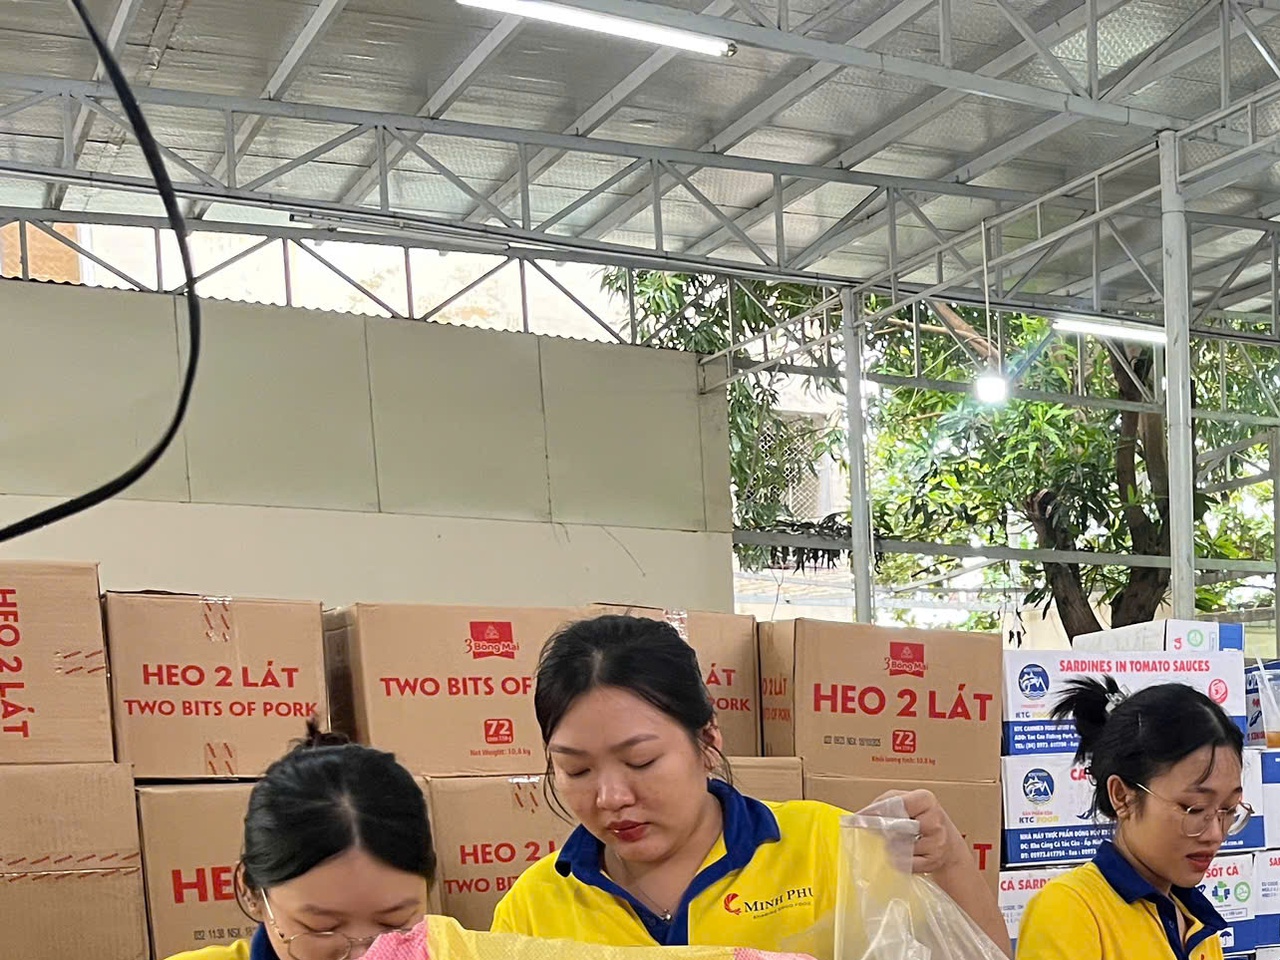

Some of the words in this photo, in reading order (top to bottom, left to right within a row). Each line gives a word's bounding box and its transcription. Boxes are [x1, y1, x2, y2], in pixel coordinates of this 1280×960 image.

[142, 664, 205, 687] HEO
[215, 666, 233, 687] 2
[242, 661, 299, 688] LÁT
[705, 663, 736, 687] ÁT
[1059, 660, 1112, 672] SARDINES
[1115, 661, 1127, 672] IN
[1130, 661, 1170, 672] TOMATO
[1173, 660, 1210, 672] SAUCES
[380, 677, 441, 696] TWO
[447, 677, 495, 696] BITS
[501, 677, 532, 695] OF
[123, 700, 176, 716] TWO
[182, 701, 222, 717] BITS
[229, 702, 256, 717] OF
[263, 702, 318, 717] PORK
[813, 683, 885, 715] HEO
[897, 689, 917, 717] 2
[928, 684, 993, 721] LÁT
[486, 720, 510, 735] 72
[894, 731, 914, 745] 72
[460, 842, 516, 865] HEO
[524, 841, 541, 862] 2
[172, 866, 236, 904] HE
[444, 878, 491, 894] TWO
[743, 894, 784, 912] MINH
